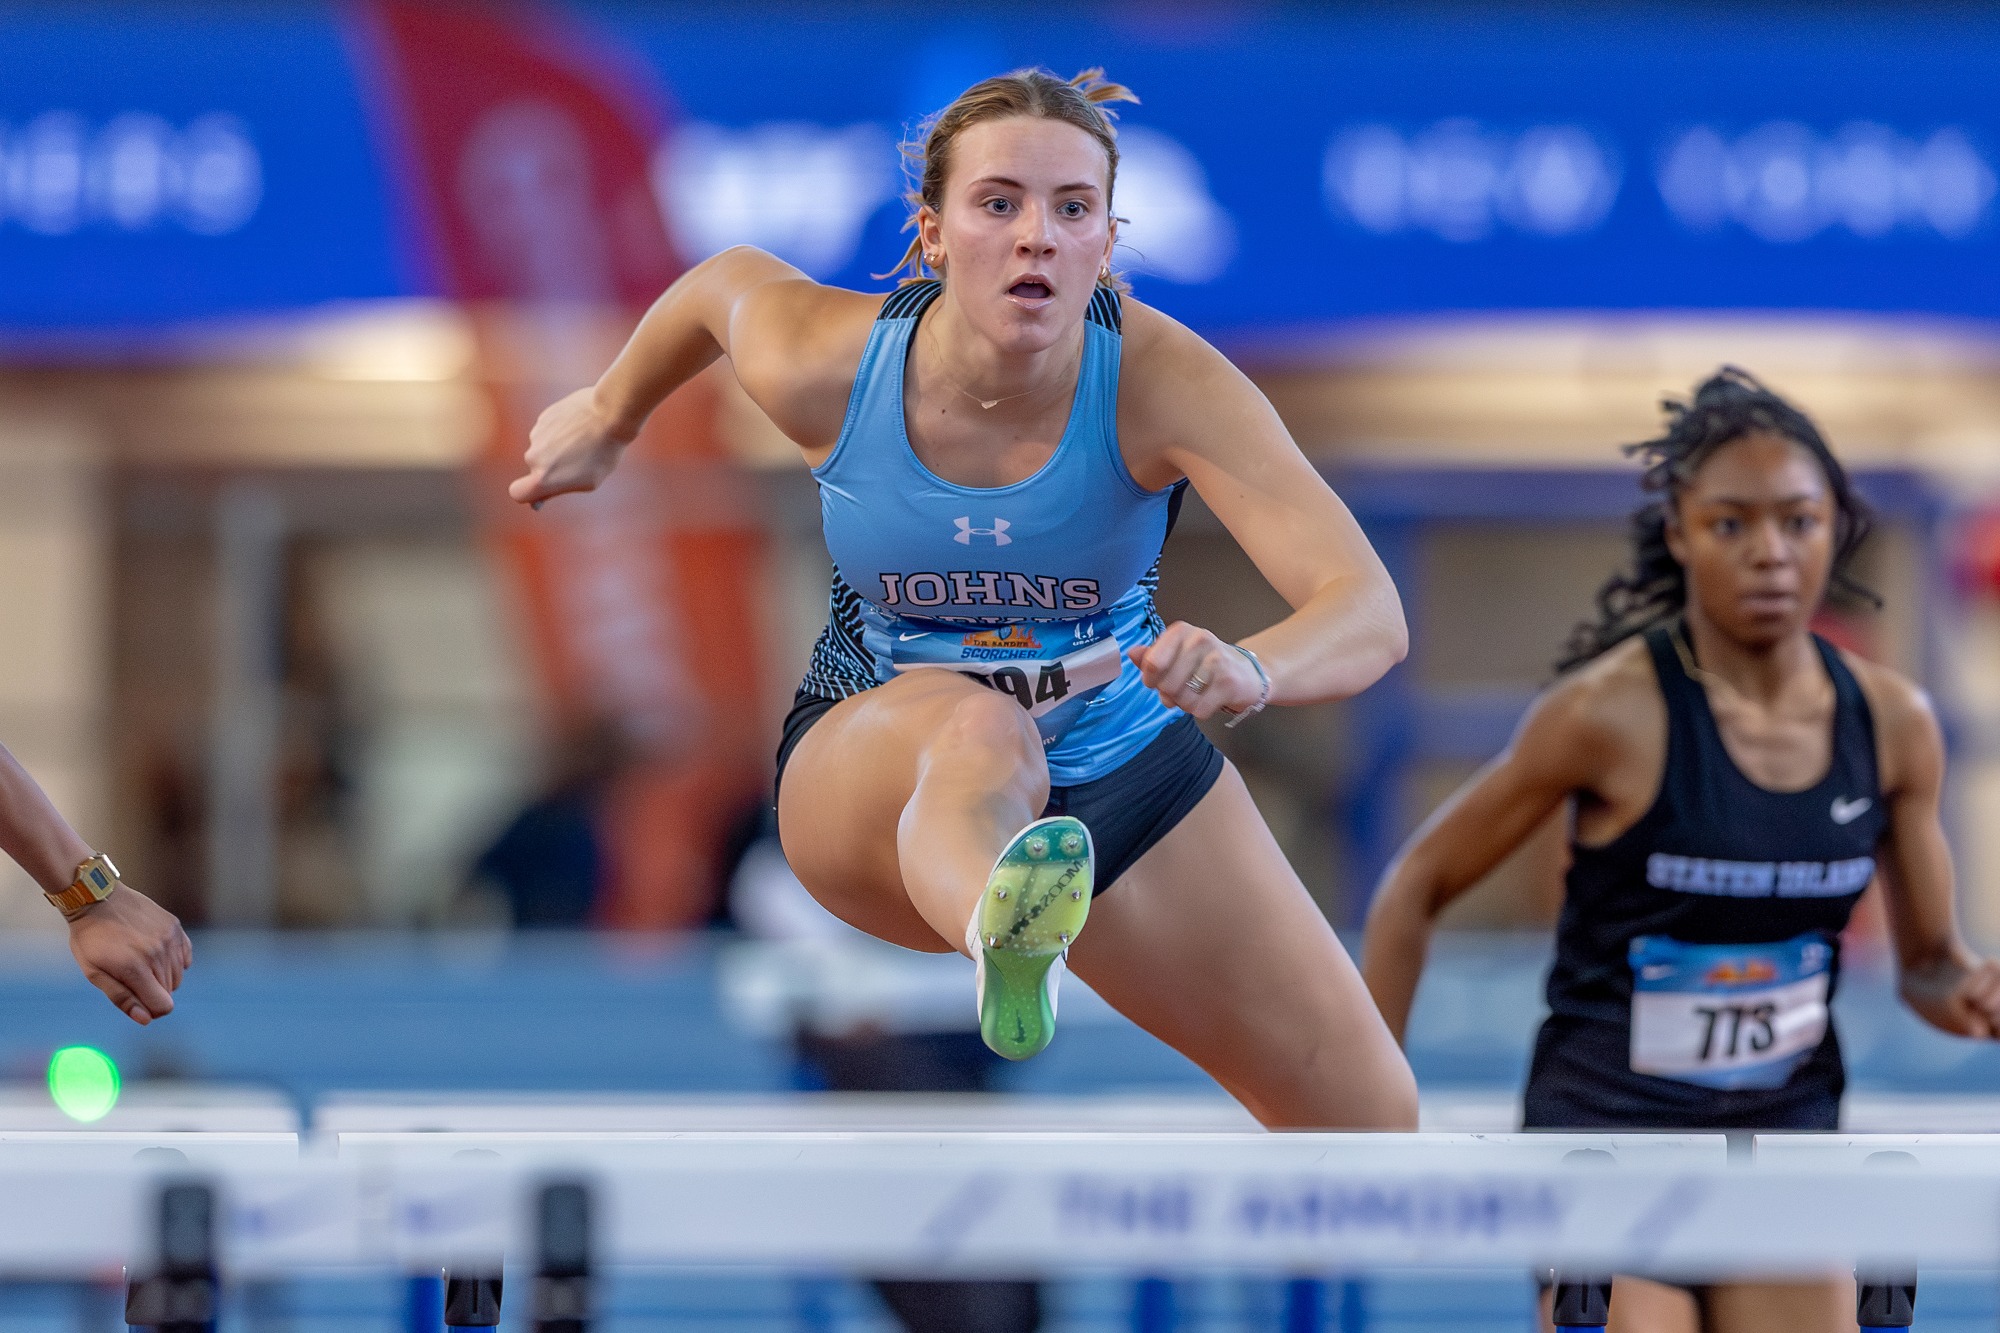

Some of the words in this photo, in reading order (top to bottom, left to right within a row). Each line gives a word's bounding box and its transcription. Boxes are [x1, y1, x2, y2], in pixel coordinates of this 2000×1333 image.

[879, 571, 1101, 610] JOHNS
[962, 661, 1072, 711] 94
[1041, 860, 1083, 907] ZOOM
